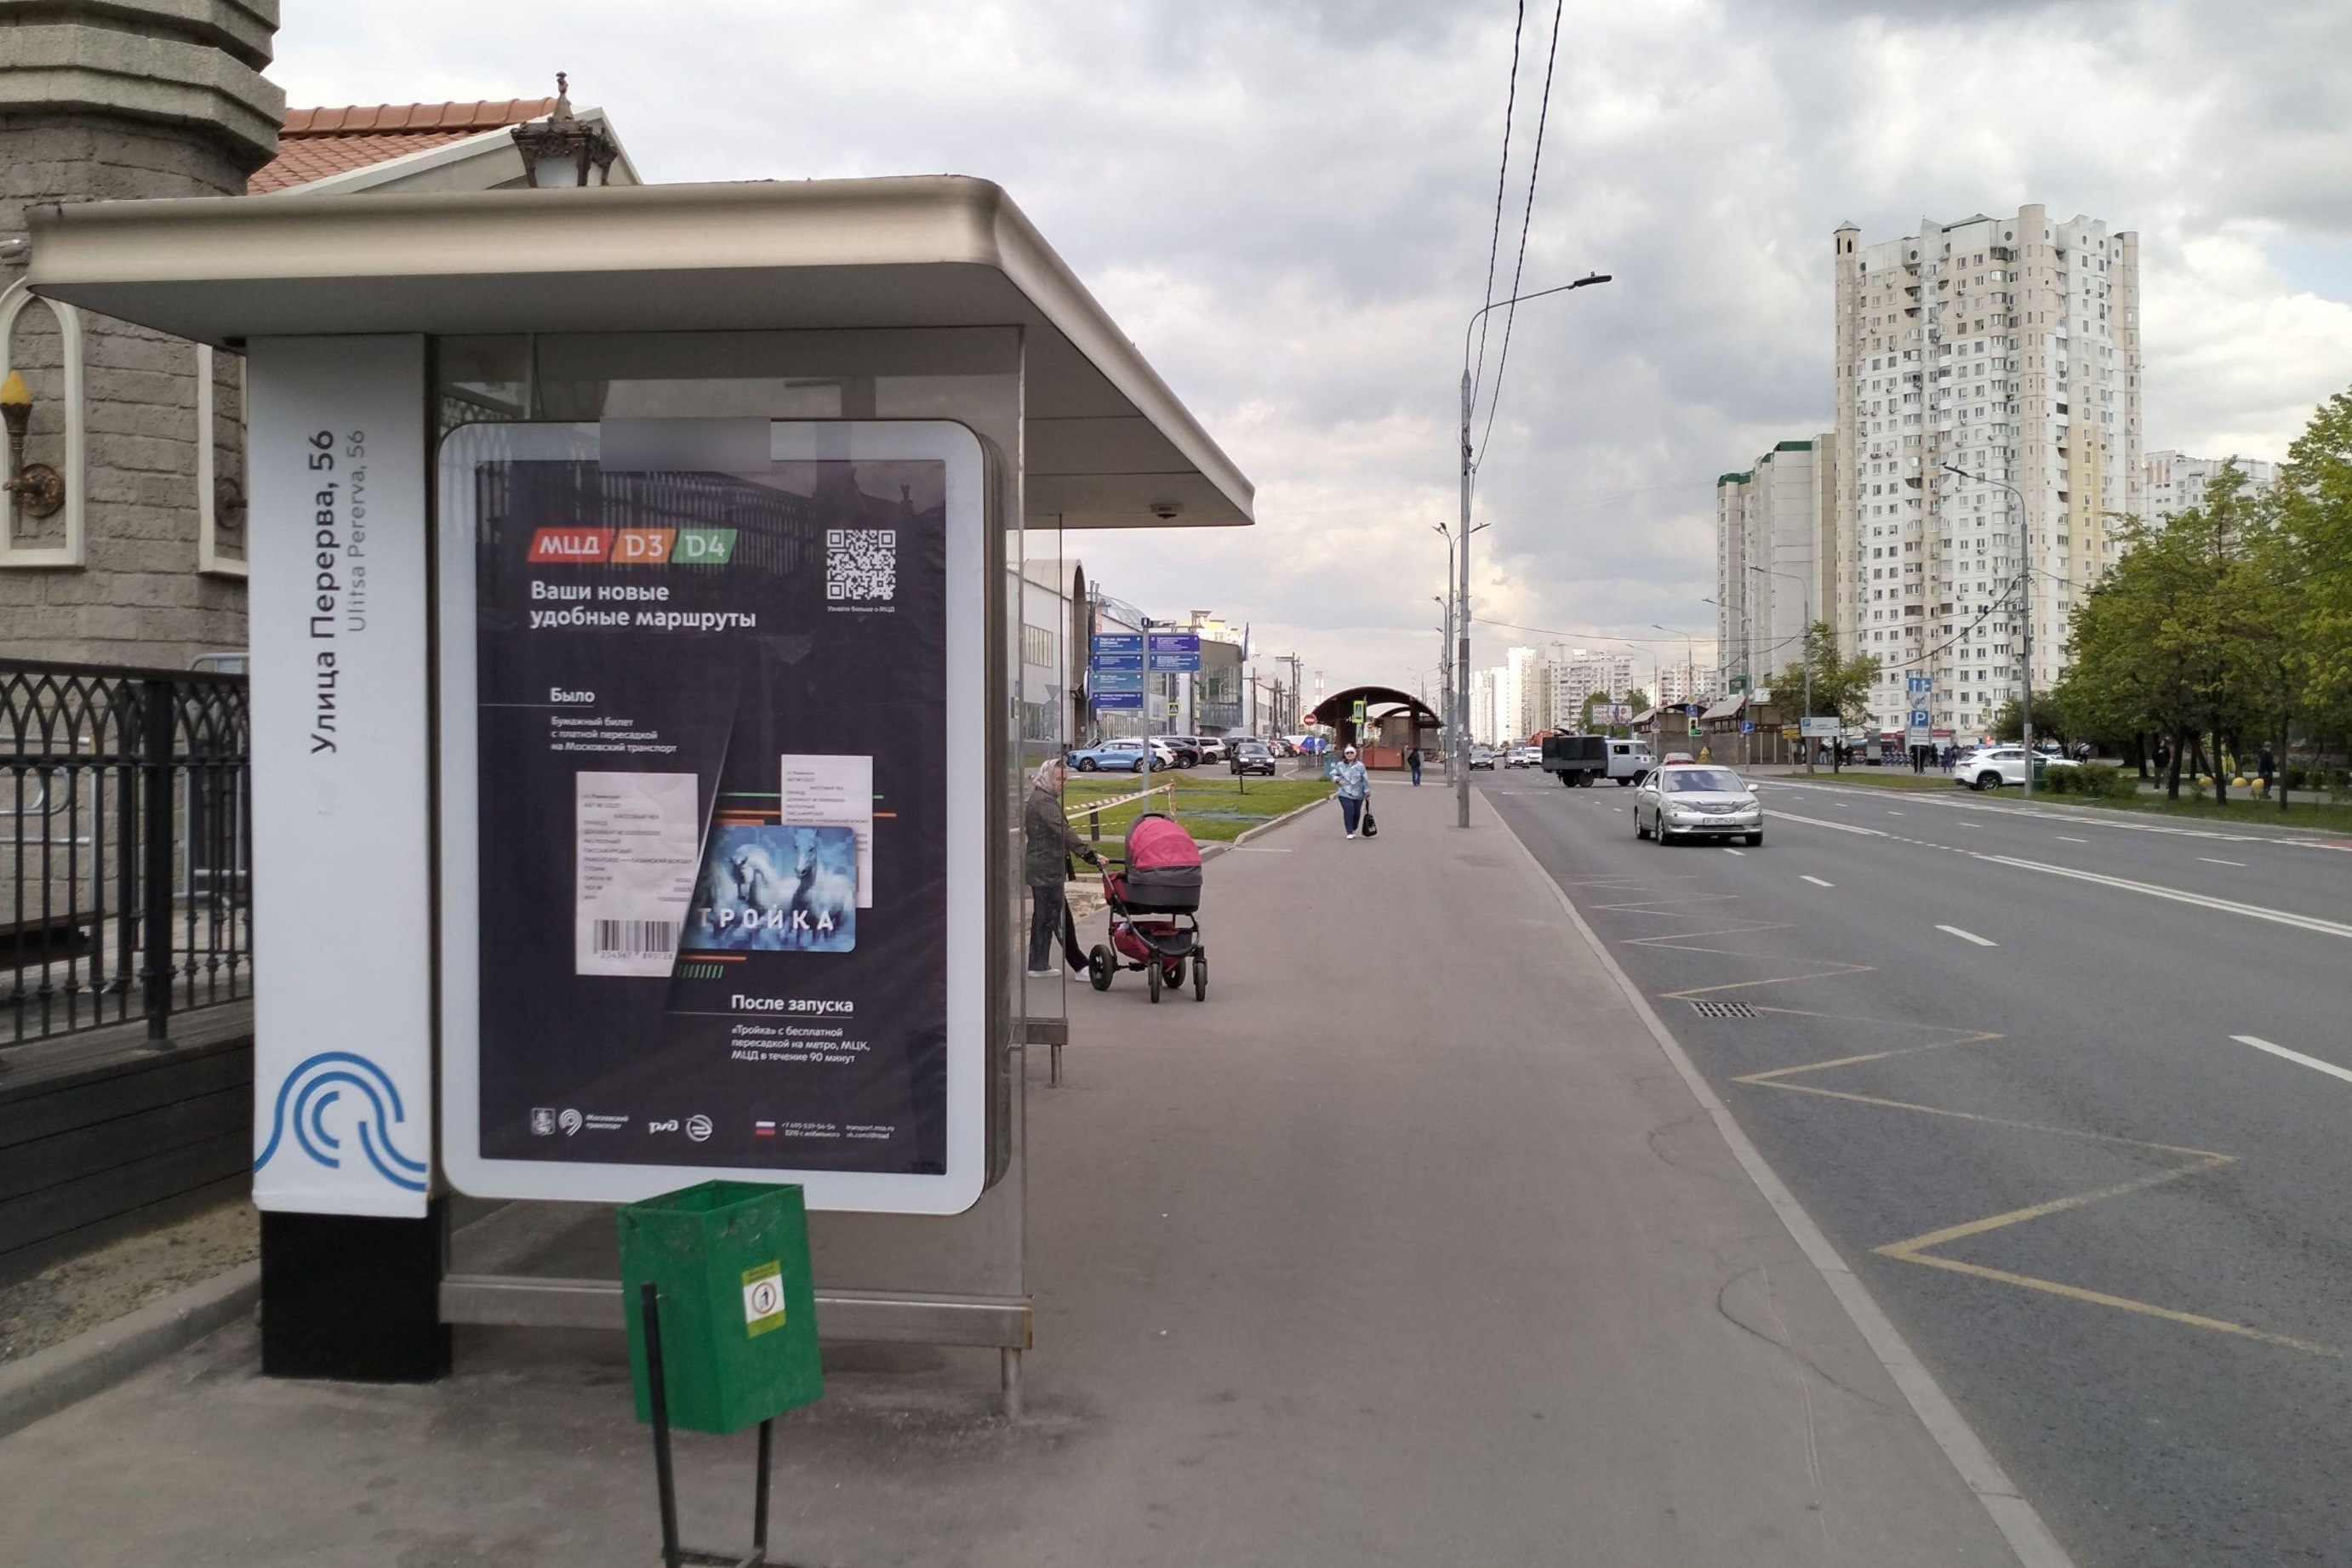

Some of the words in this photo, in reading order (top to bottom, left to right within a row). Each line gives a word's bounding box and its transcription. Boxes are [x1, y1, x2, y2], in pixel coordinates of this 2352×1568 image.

[308, 430, 334, 470] 56
[346, 430, 365, 458] 56
[347, 465, 367, 557] Pererva,
[539, 535, 600, 555] МЦД
[625, 534, 664, 557] D3
[685, 534, 725, 558] D4
[311, 482, 340, 638] Перерва,
[347, 566, 366, 631] Ulitsa
[530, 580, 592, 601] Ваши
[598, 584, 670, 602] новые
[529, 606, 631, 629] удобные
[635, 612, 756, 631] маршруты
[311, 651, 340, 754] Улица
[550, 687, 596, 703] Было
[551, 716, 603, 727] Бумажный
[604, 716, 635, 727] билет
[559, 730, 598, 738] платной
[600, 731, 659, 740] пересадкой
[564, 742, 626, 752] Московский
[627, 744, 678, 754] транспорт
[698, 904, 834, 931] ТРОЙКА
[731, 994, 785, 1010] После
[788, 999, 854, 1015] запуска
[731, 1025, 776, 1036] «Тройка»
[785, 1026, 843, 1037] бесплатной
[731, 1039, 790, 1049] пересадкой
[805, 1041, 839, 1051] метро,
[841, 1041, 871, 1052] МЦК,
[731, 1050, 759, 1062] МЦД
[768, 1053, 808, 1062] течение
[809, 1052, 823, 1062] 90
[825, 1055, 855, 1064] минут
